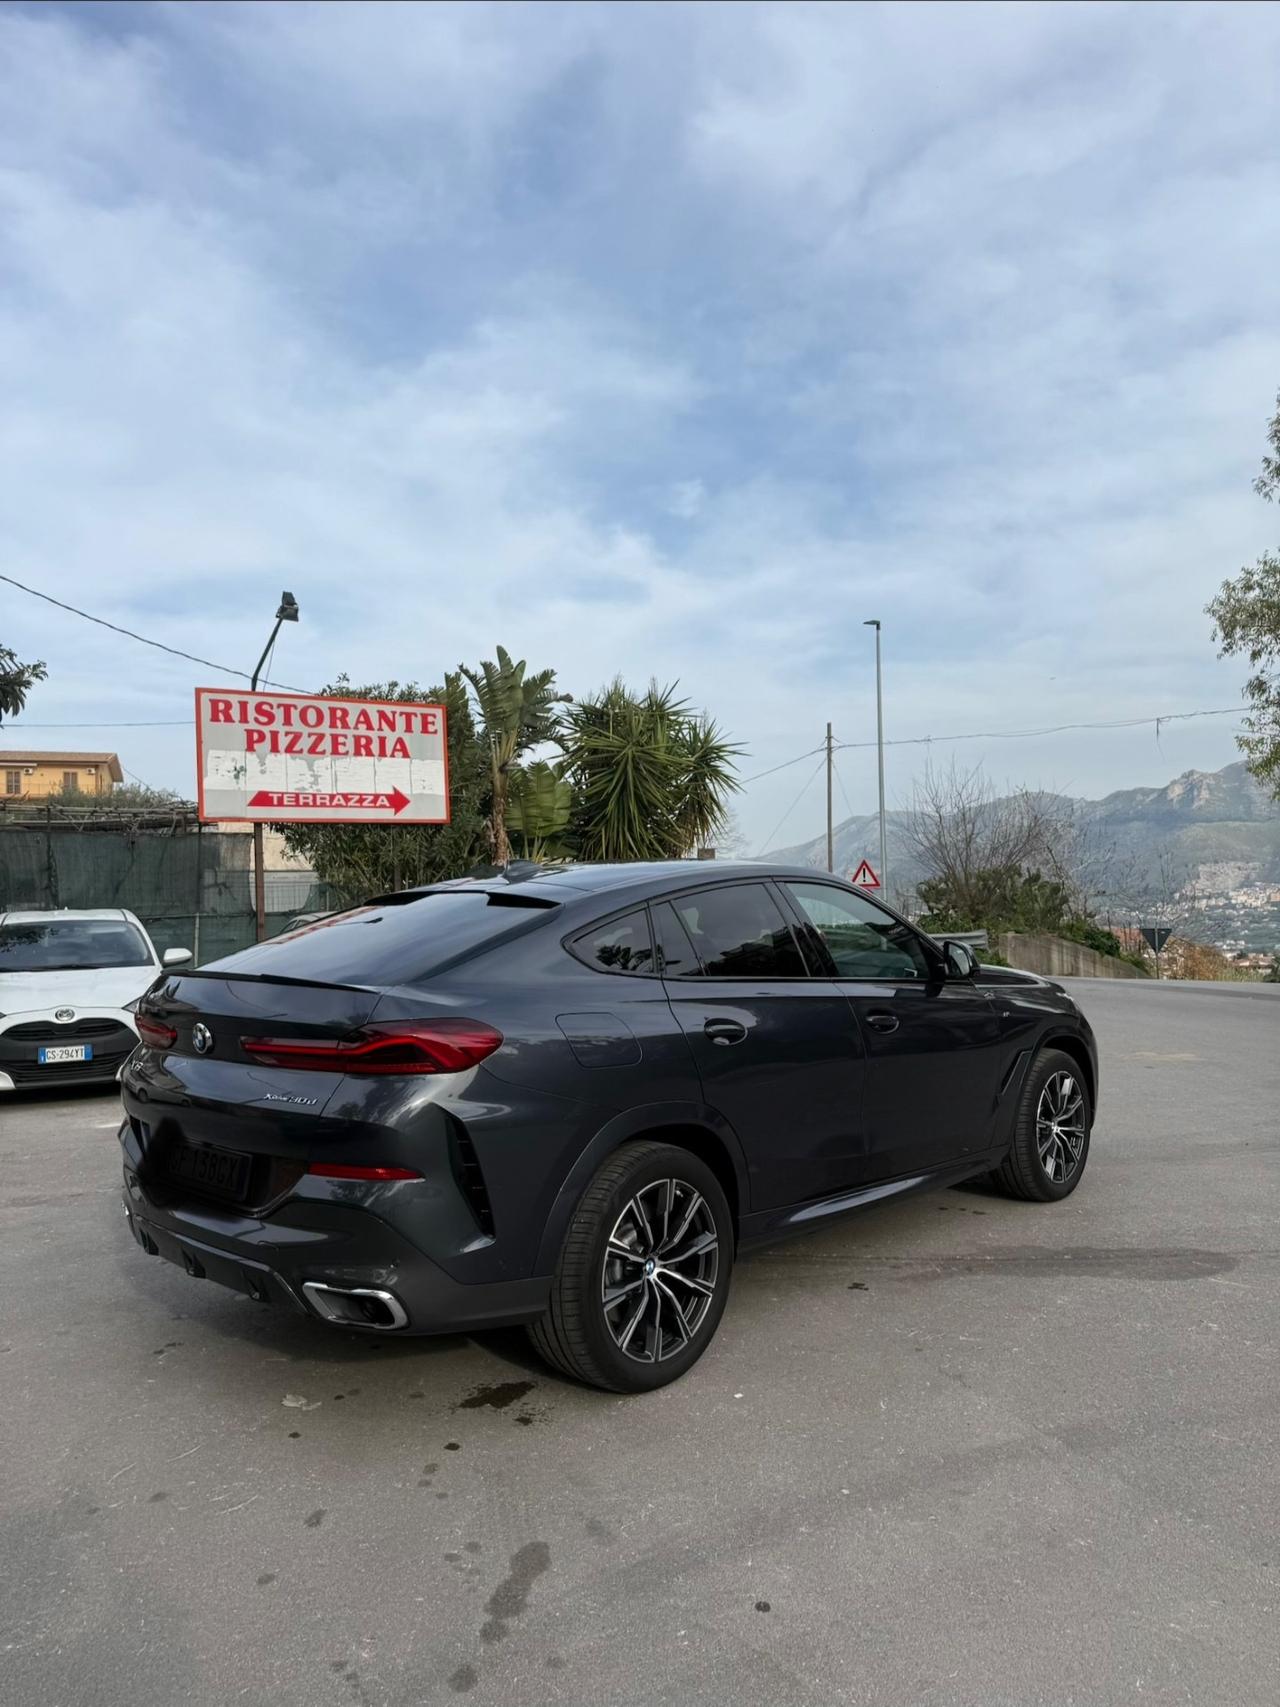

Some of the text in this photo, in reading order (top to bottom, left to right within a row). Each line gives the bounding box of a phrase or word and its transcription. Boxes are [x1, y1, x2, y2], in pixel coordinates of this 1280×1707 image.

[209, 698, 438, 734] RISTORANTE
[244, 728, 411, 759] PIZZERIA
[268, 792, 391, 807] TERRAZZA
